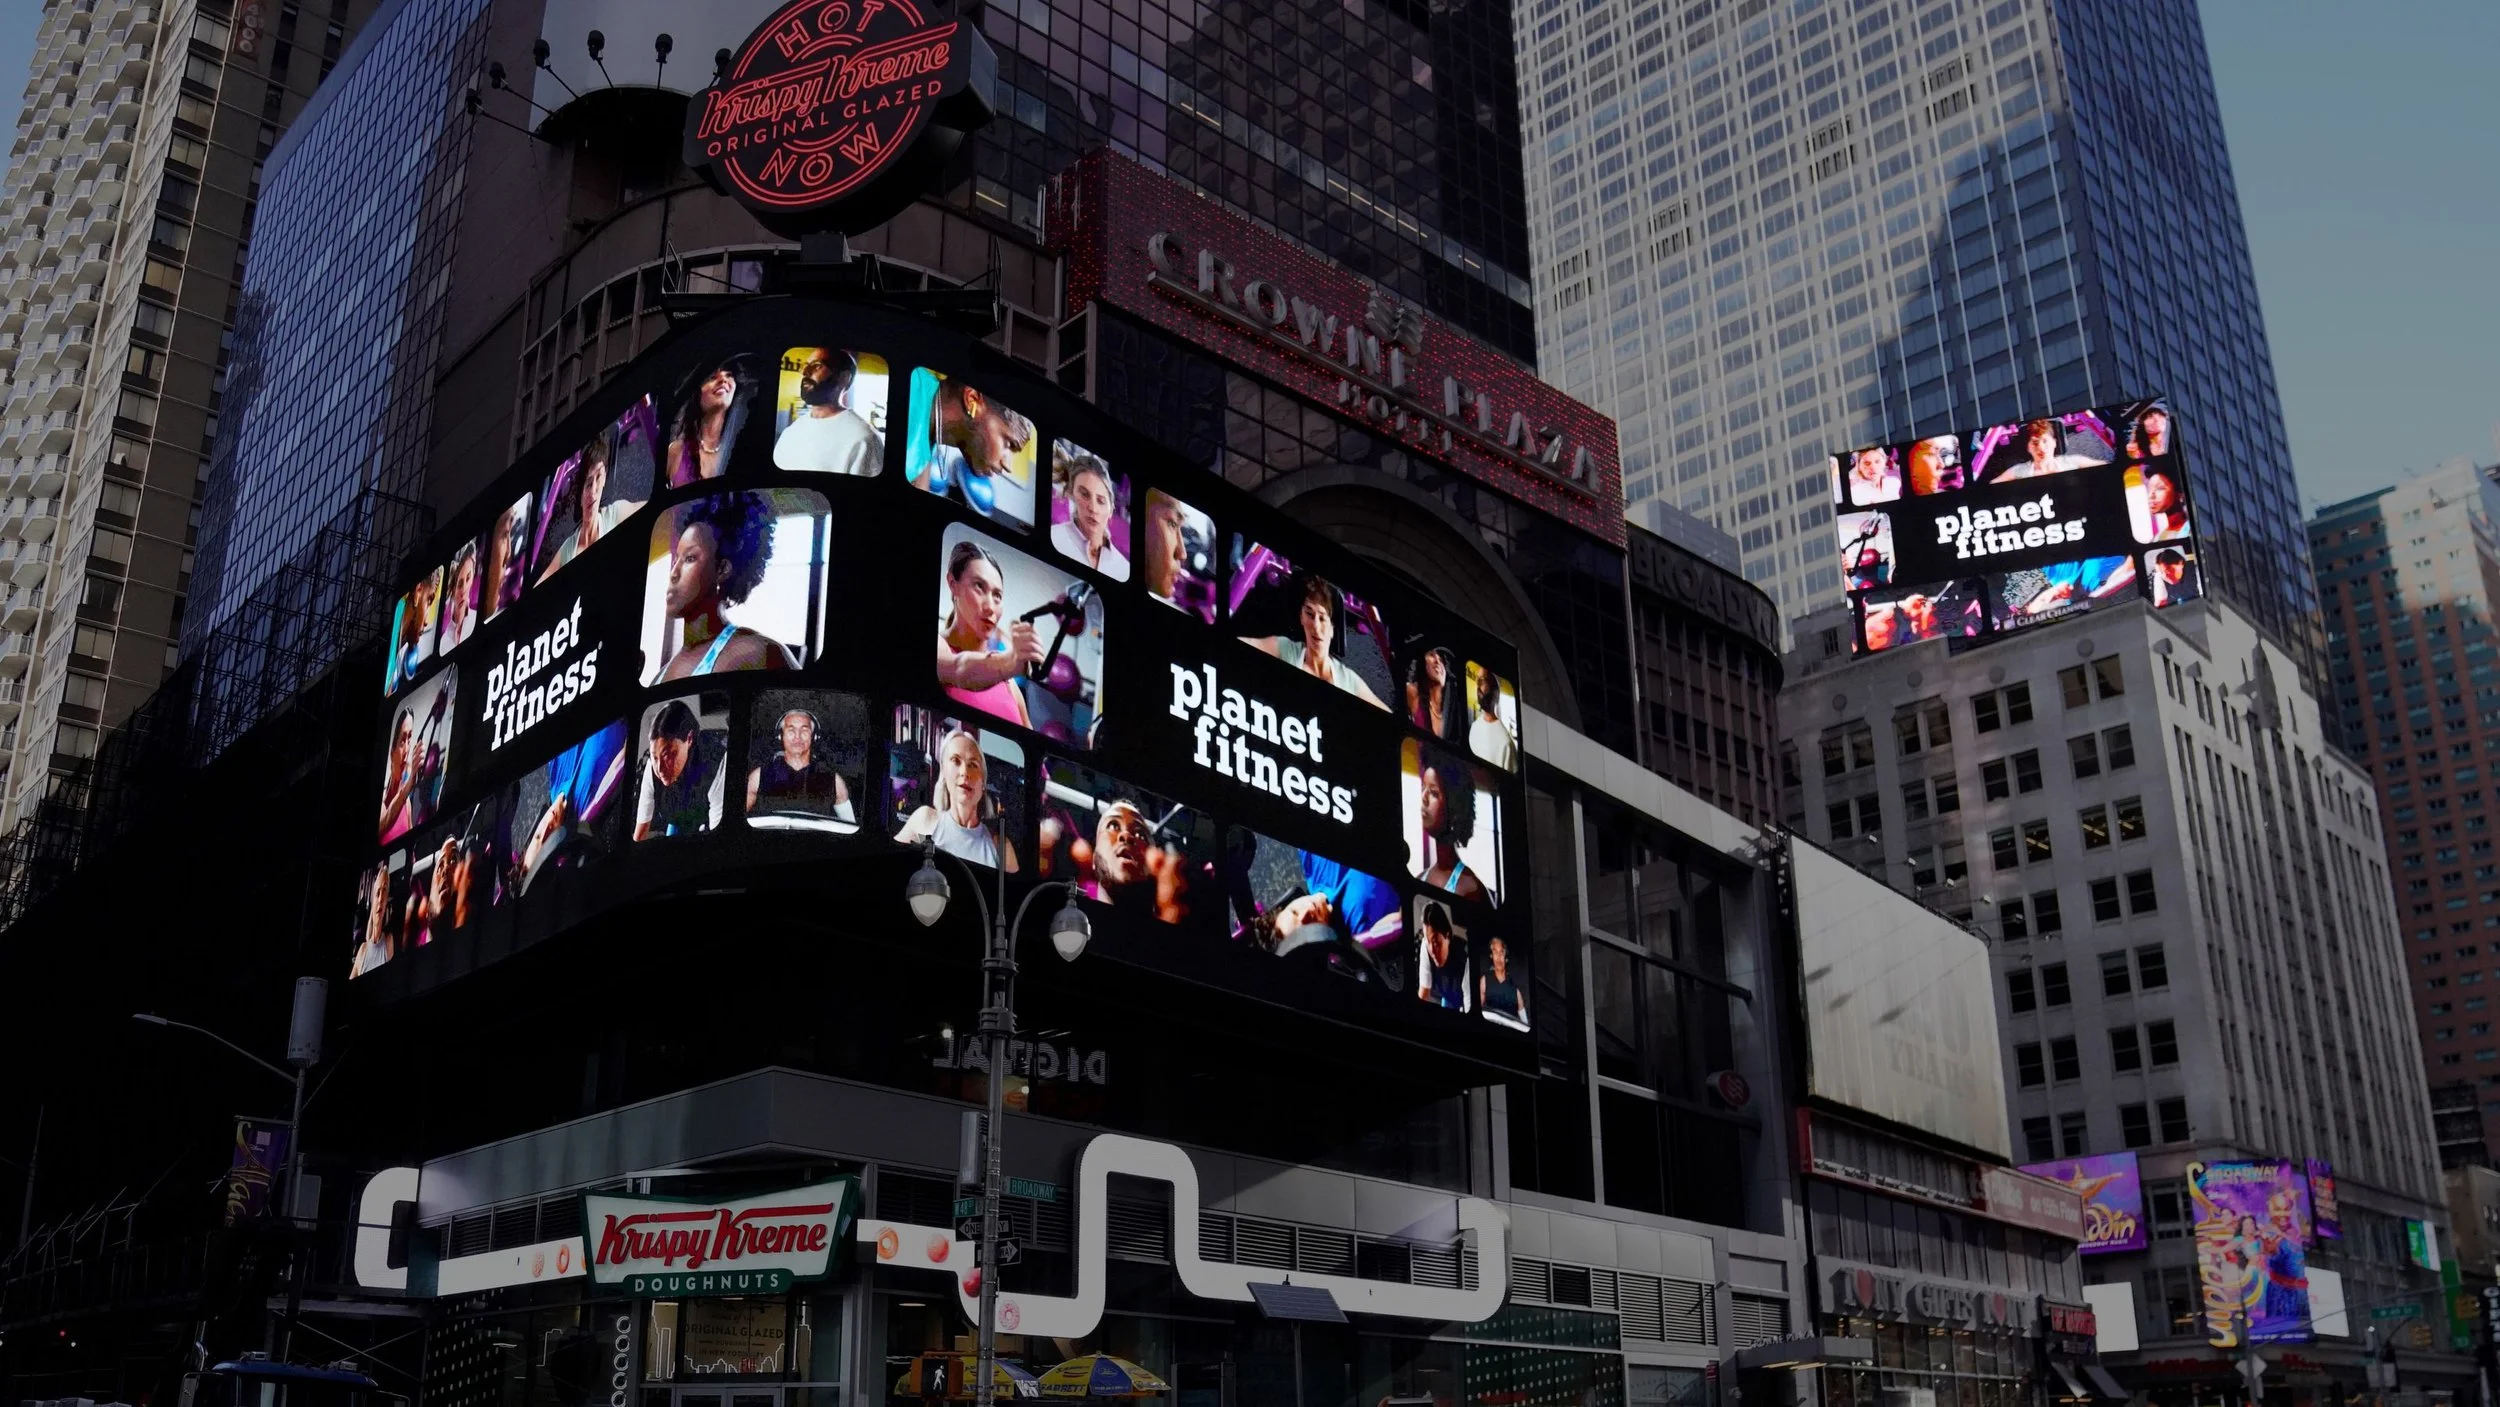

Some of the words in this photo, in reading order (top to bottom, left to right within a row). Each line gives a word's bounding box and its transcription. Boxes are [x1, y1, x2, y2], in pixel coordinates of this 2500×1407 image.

[774, 1, 885, 58] HOT
[697, 58, 831, 139] Krispy
[822, 22, 958, 104] Kreme
[707, 112, 829, 157] ORIGINAL
[843, 80, 943, 119] GLAZED
[759, 121, 881, 187] NOW
[1443, 375, 1601, 492] PLAZA
[1935, 494, 2056, 544] planet
[1956, 518, 2087, 559] fitness
[1631, 534, 1777, 650] BROADW
[2016, 612, 2047, 627] CLEAR
[483, 596, 583, 722] planet
[490, 647, 600, 751] fitness
[1169, 662, 1323, 763] planet
[1193, 714, 1355, 824] fitness
[1011, 1178, 1055, 1200] BROADWAY
[595, 1209, 718, 1270] Krispy
[709, 1203, 834, 1260] Kreme
[964, 1223, 981, 1234] ONE
[634, 1273, 780, 1293] DOUGHNUTS
[740, 1327, 784, 1339] GLAZED
